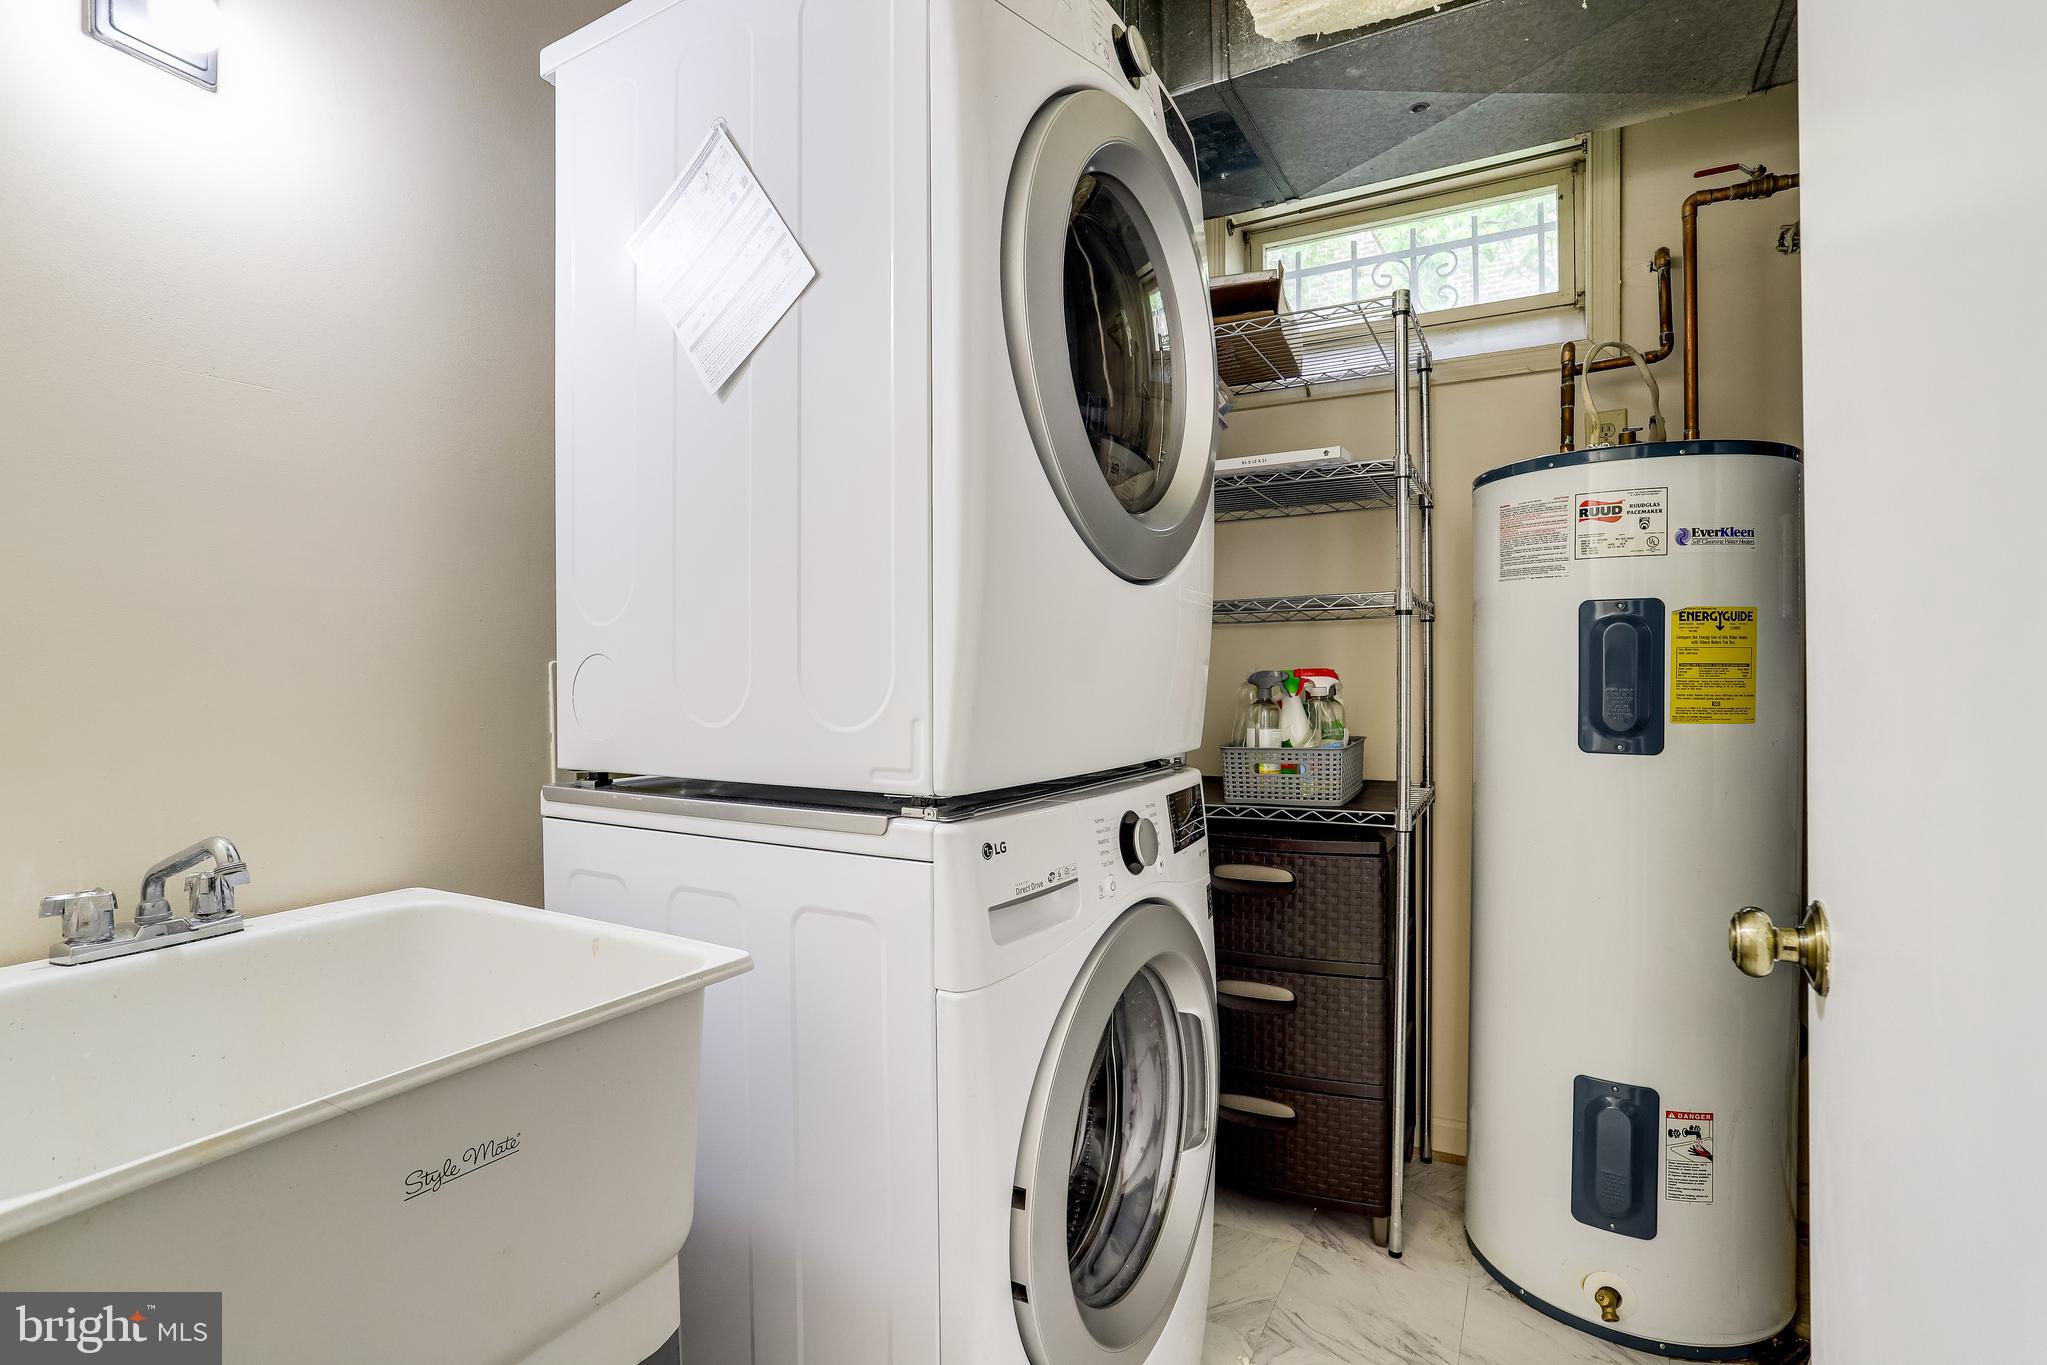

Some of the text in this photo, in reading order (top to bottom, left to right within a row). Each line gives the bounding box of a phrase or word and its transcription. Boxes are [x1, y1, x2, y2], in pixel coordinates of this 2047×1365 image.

[1579, 505, 1622, 518] RUUD
[1691, 526, 1755, 538] EverKleen
[1678, 611, 1753, 622] ENERGYGUIDE
[994, 841, 1007, 855] LG
[1015, 883, 1031, 896] Direct
[1031, 880, 1044, 891] Drive
[405, 1136, 520, 1195] Style Mate
